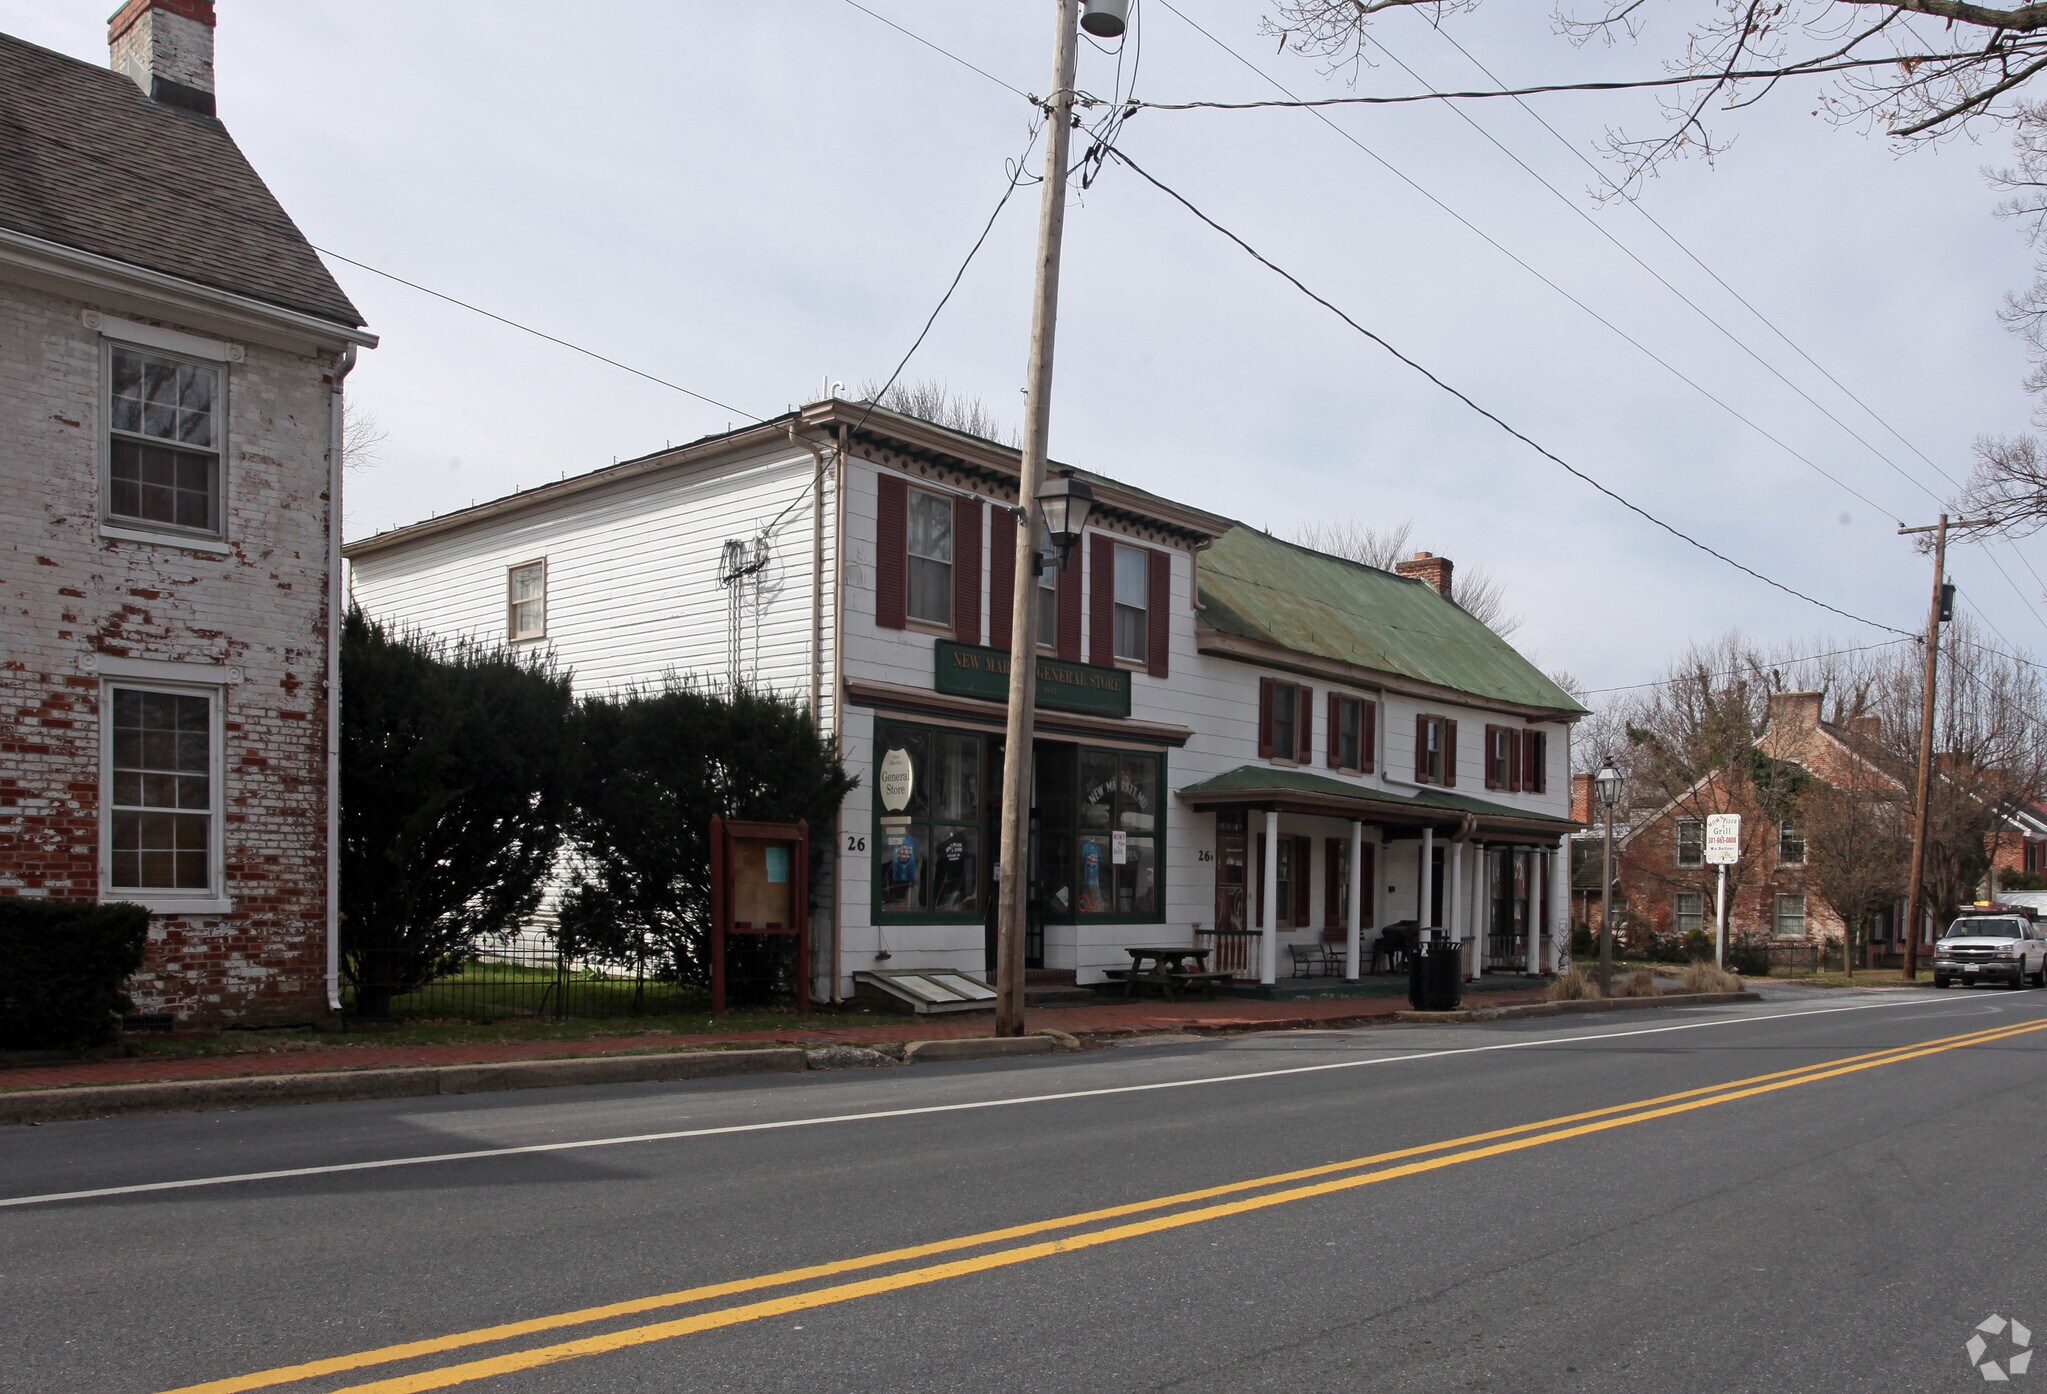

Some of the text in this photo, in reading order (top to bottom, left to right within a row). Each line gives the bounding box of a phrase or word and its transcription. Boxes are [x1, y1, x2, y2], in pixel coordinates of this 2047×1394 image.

[953, 652, 980, 669] NEW
[1036, 666, 1085, 686] GENERAL
[1089, 675, 1121, 692] STORE
[881, 770, 910, 783] General
[886, 784, 906, 796] Store
[1088, 784, 1105, 806] NEW
[1713, 827, 1731, 835] Grill
[848, 836, 865, 851] 26
